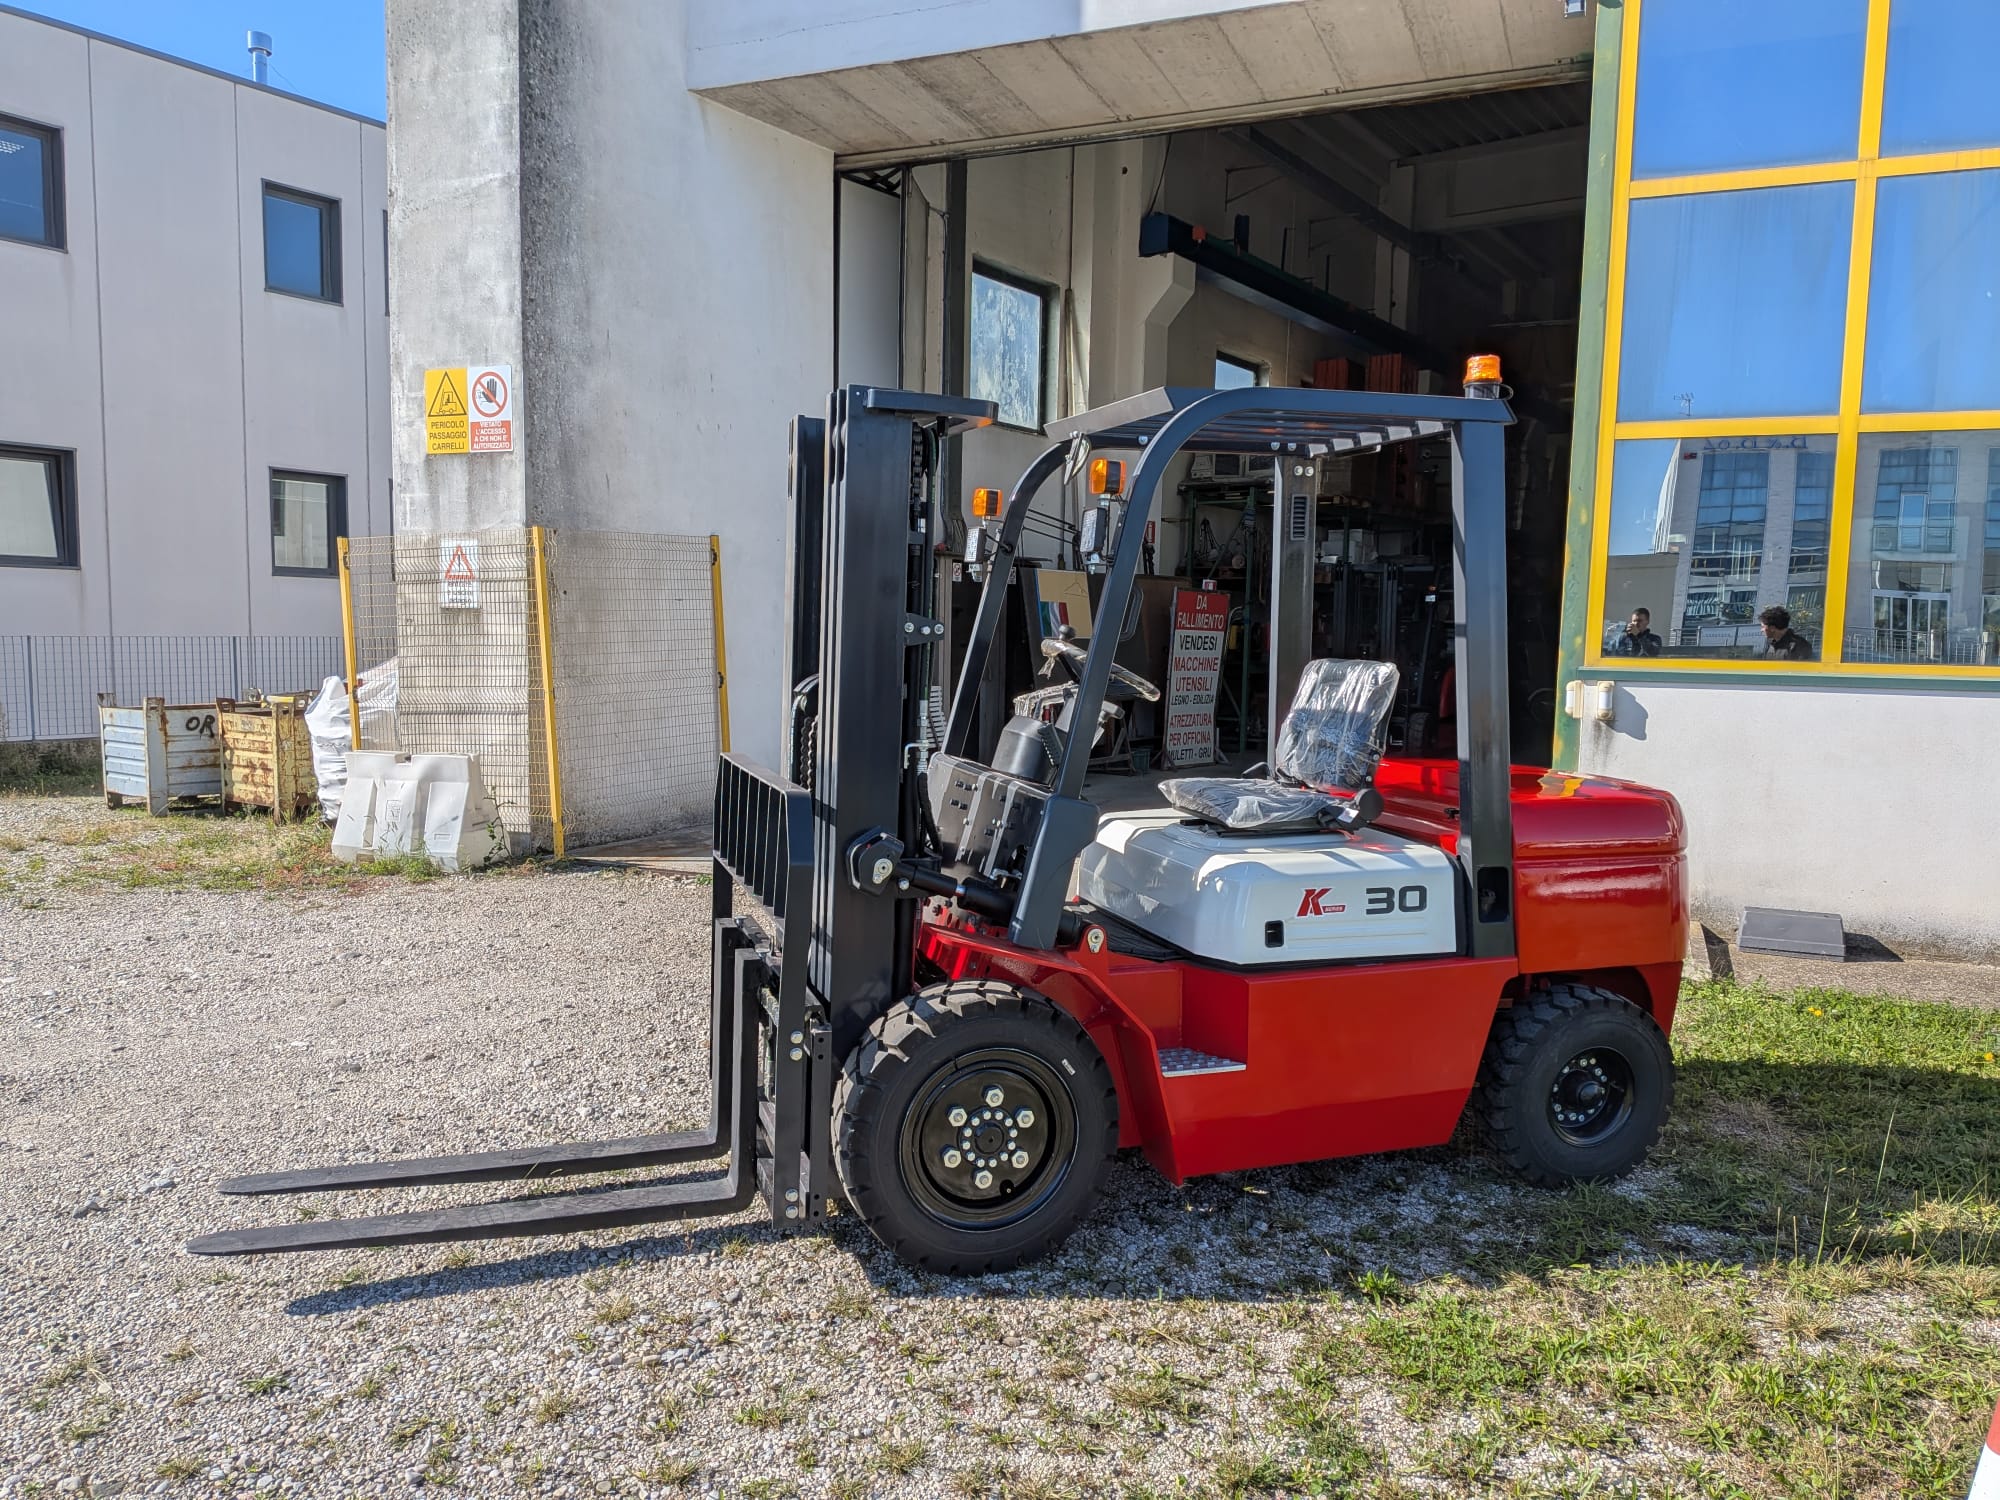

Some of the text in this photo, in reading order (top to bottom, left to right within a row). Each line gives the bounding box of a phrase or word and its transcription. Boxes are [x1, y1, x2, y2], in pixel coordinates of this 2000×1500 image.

[431, 421, 465, 429] PERICOLO
[429, 431, 467, 440] PASSAGGIO
[432, 442, 465, 450] CARRELLI
[1196, 594, 1208, 610] DA
[1177, 612, 1224, 629] FALLIMENTO
[1179, 634, 1218, 651] VENDESI
[1173, 656, 1219, 672] MACCHINE
[1175, 676, 1213, 692] UTENSILI
[1171, 694, 1189, 705] LEGNO
[1193, 694, 1214, 705] EDILIZIA
[185, 714, 215, 738] OR
[1170, 713, 1212, 728] ATREZZATURA
[1169, 730, 1211, 746] PER OFFICINA
[1168, 748, 1194, 760] MULETTI
[1198, 747, 1212, 759] GRU
[1297, 887, 1333, 916] K
[1365, 885, 1428, 914] 30
